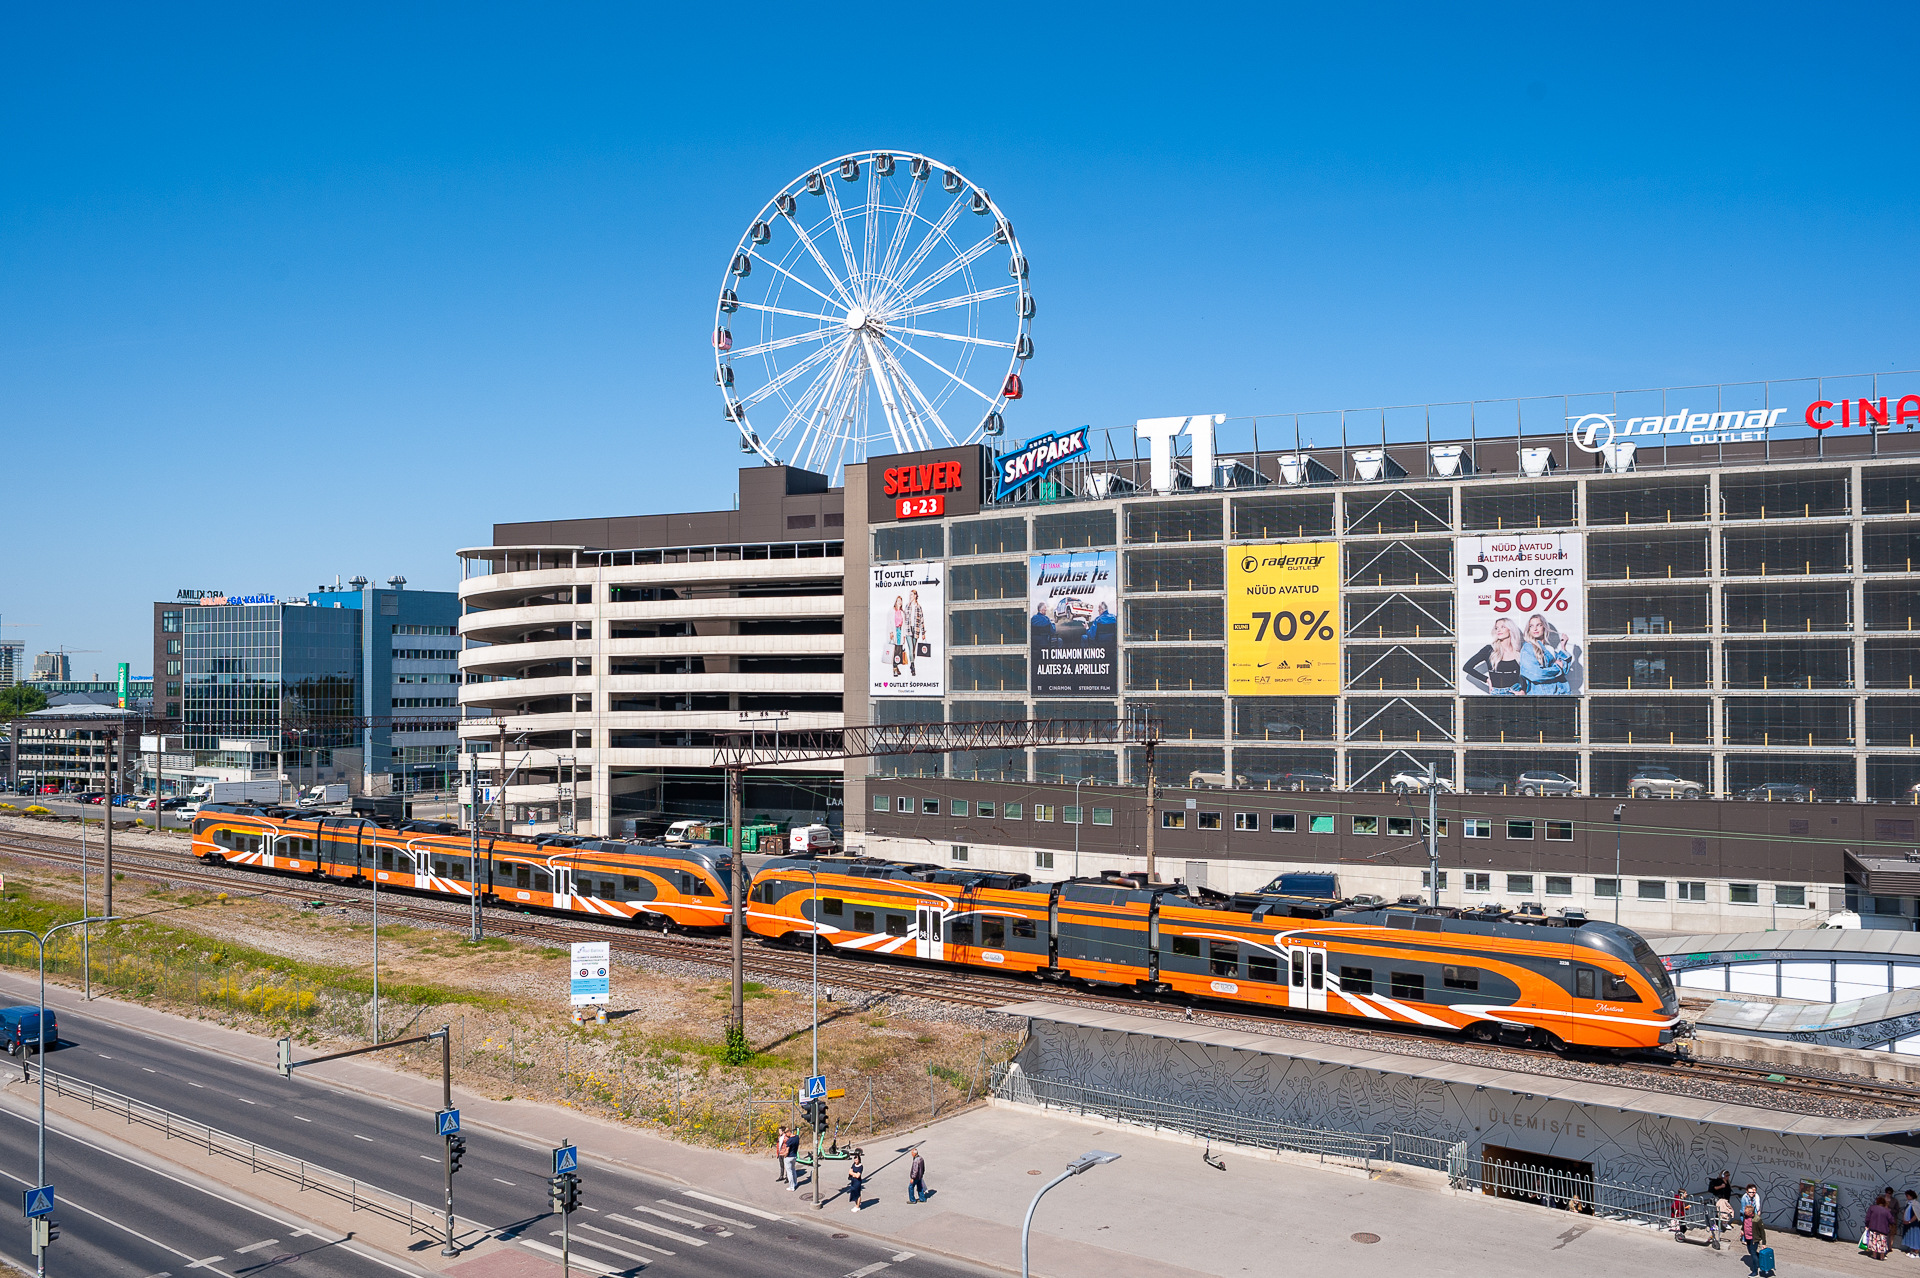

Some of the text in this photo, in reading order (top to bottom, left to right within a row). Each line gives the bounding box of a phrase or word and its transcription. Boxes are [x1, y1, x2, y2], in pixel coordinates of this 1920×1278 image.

[1624, 408, 1787, 436] rademar
[1029, 436, 1053, 449] SUPER
[1690, 430, 1765, 445] OUTLET
[1004, 431, 1083, 484] SKYPARK
[1137, 414, 1212, 489] T1
[883, 461, 962, 495] SELVER
[902, 498, 937, 515] 8-23
[1492, 542, 1553, 552] NÜÜD AVATUD
[1261, 555, 1326, 566] rademar
[1478, 553, 1568, 562] BALTIMAADE SUURIM
[884, 570, 914, 579] OUTLET
[1091, 570, 1110, 583] TEE
[1492, 567, 1574, 578] denim dream
[893, 580, 917, 588] AVATUD
[1519, 578, 1558, 586] OUTLET
[1246, 585, 1320, 595] NÜÜD AVATUD
[1479, 588, 1569, 613] -50%
[1252, 611, 1335, 642] 70%
[1041, 648, 1106, 660] T1 CINAMON KINOS
[1037, 663, 1110, 675] ALATES 26. APRILLIST
[1489, 1107, 1587, 1138] ÜLEMISTE
[1750, 1143, 1804, 1160] PLATVORM
[1820, 1154, 1855, 1168] TARTU
[1830, 1166, 1875, 1182] TALLINN
